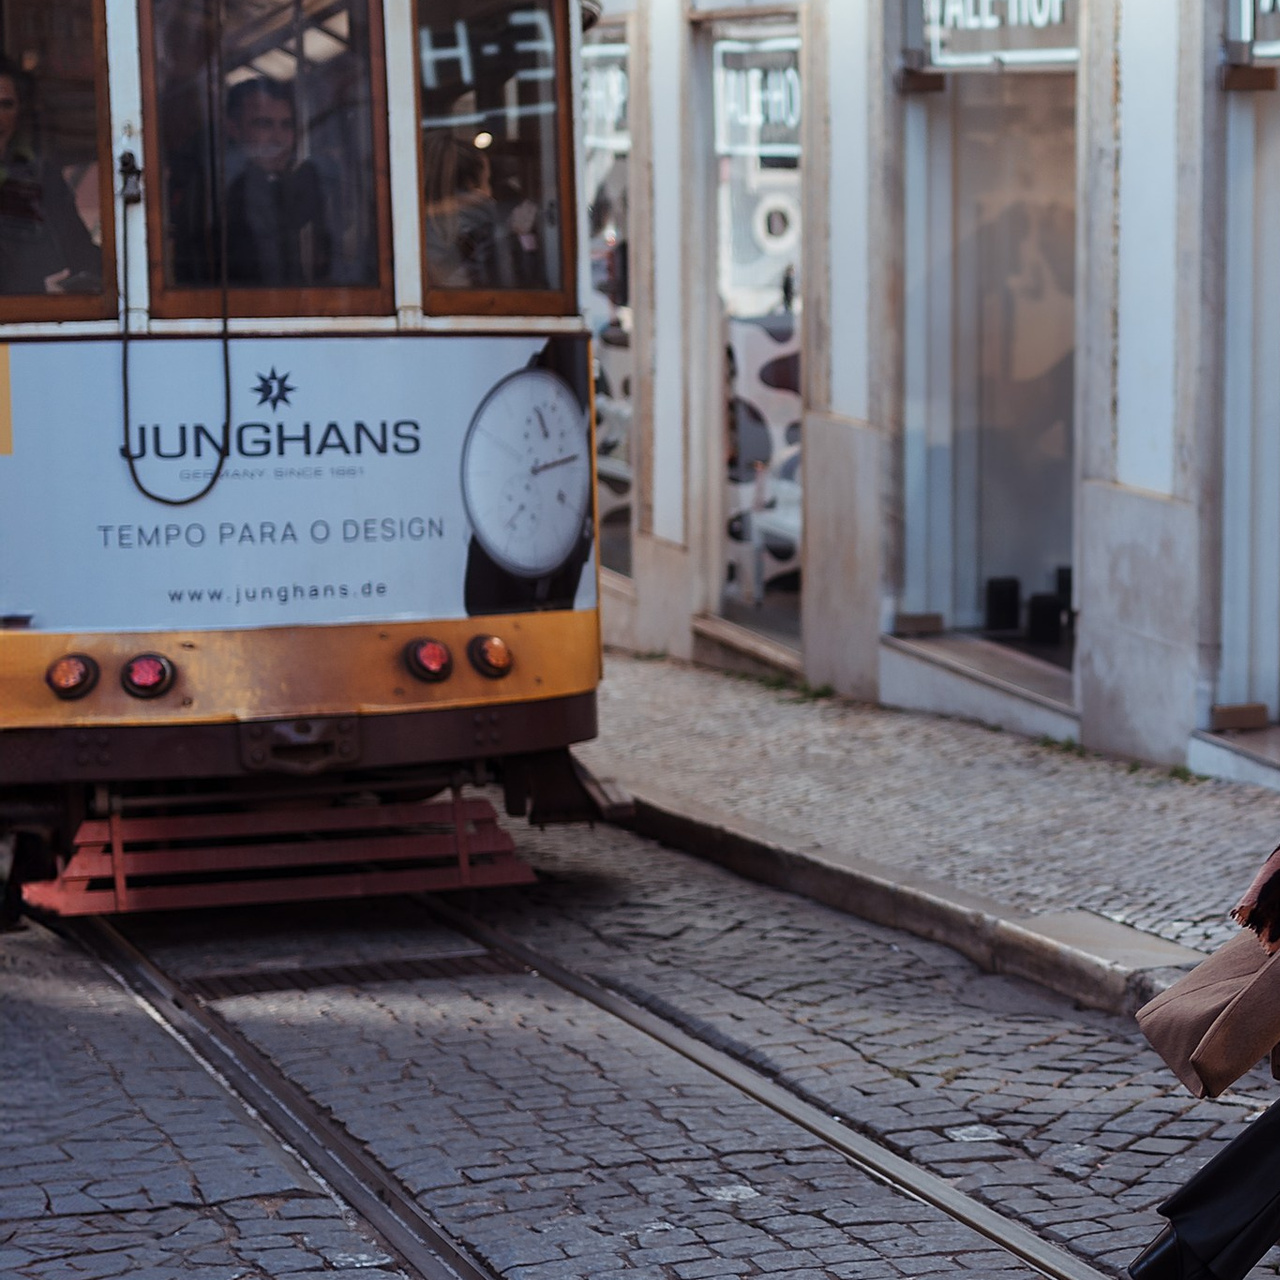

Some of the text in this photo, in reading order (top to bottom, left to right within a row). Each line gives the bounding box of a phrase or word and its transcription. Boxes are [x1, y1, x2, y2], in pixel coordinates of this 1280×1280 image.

[119, 420, 421, 459] JUNGHANS
[273, 466, 324, 480] SINCE
[98, 517, 444, 548] TEMPO PARA O DESIGN
[168, 581, 388, 605] www.junghans.de
